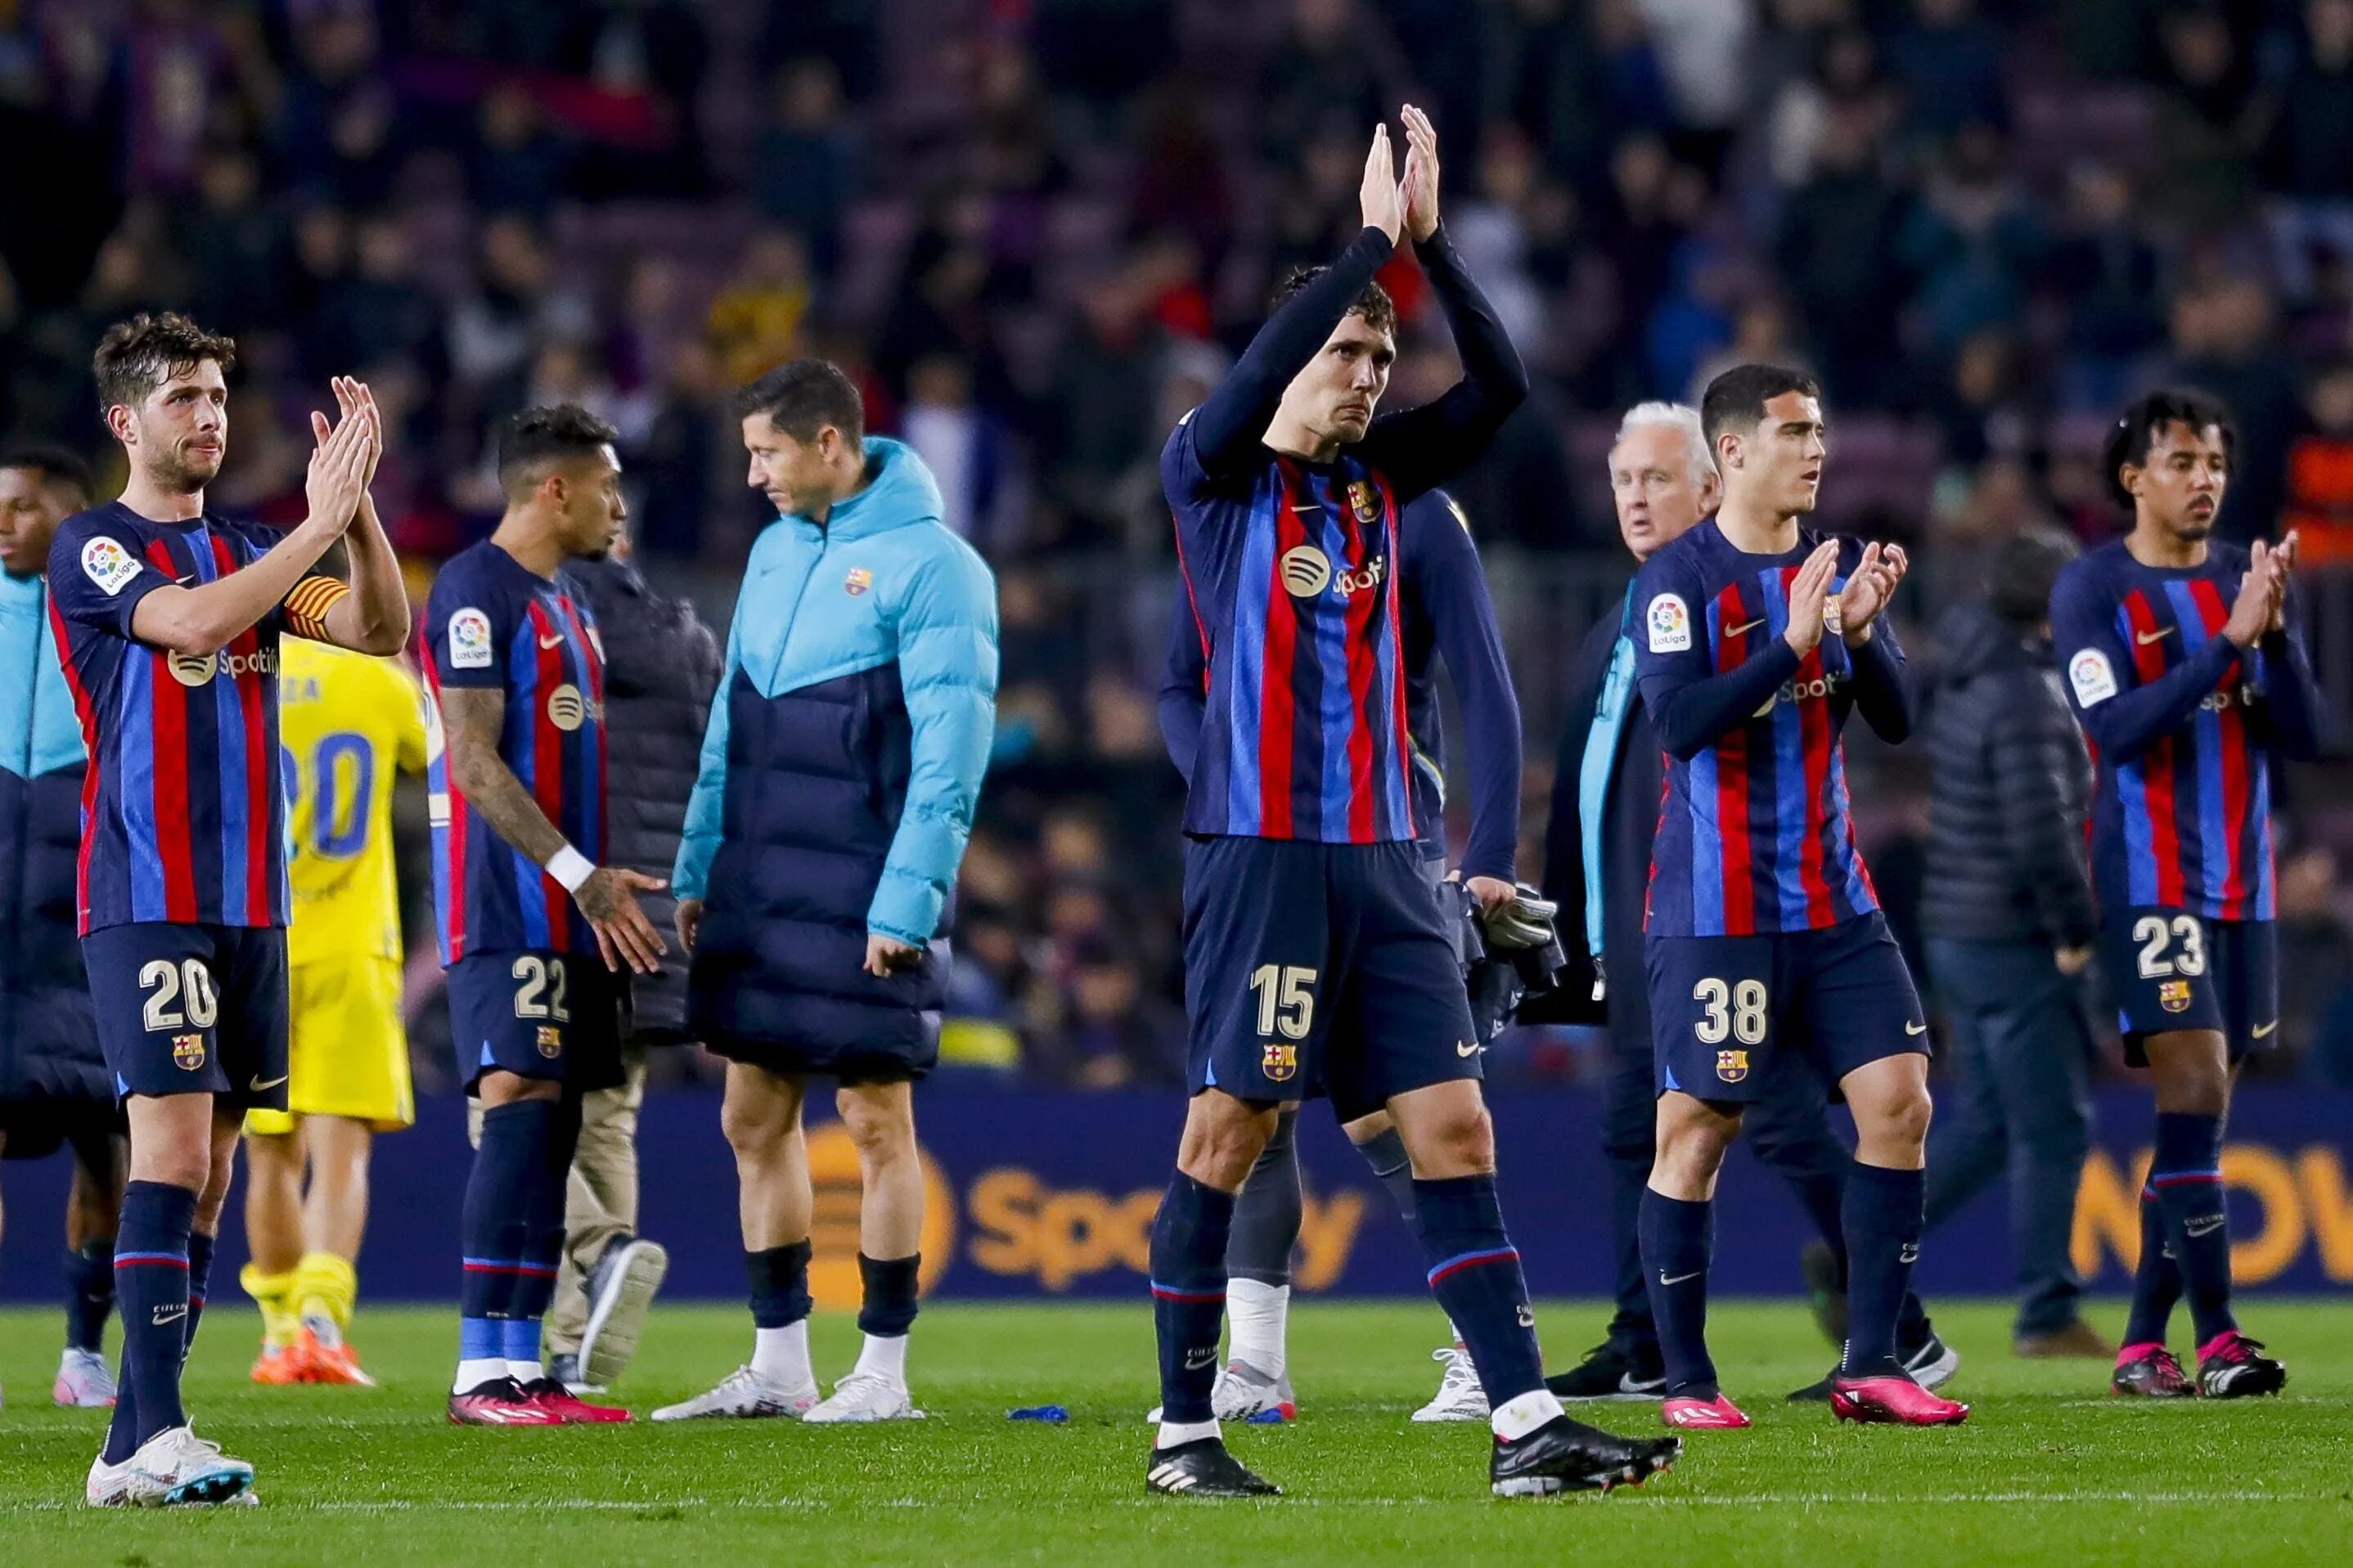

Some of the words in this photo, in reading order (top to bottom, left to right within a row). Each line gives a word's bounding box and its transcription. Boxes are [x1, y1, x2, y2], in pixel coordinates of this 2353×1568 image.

[106, 561, 135, 588] LaLiga
[1654, 636, 1686, 645] LaLiga
[2133, 915, 2204, 979] 23
[139, 959, 217, 1031] 20
[512, 955, 569, 1022] 22
[1250, 964, 1317, 1040] 15
[1694, 977, 1766, 1045] 38
